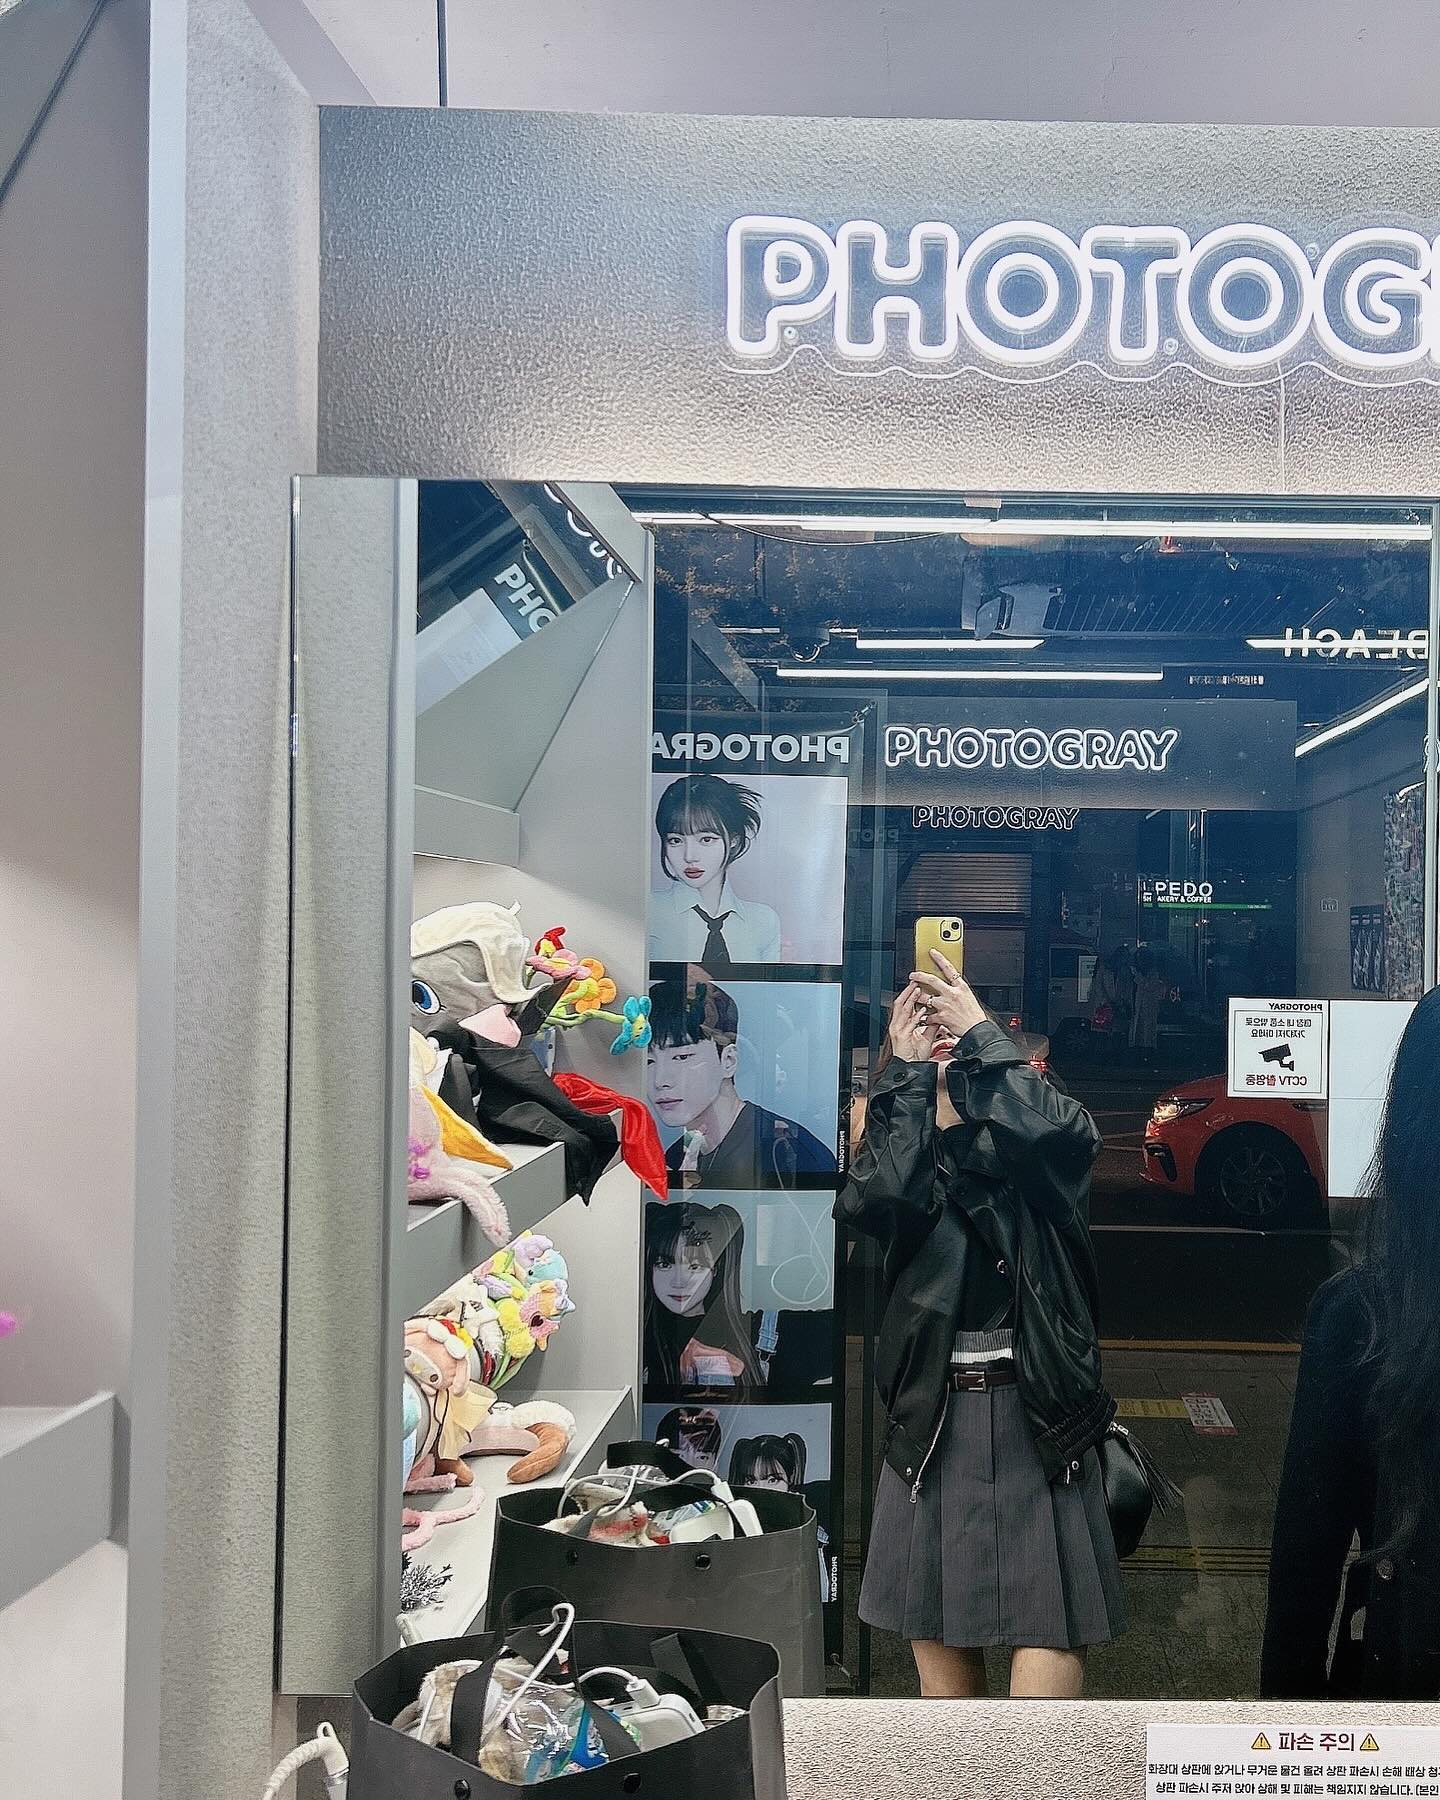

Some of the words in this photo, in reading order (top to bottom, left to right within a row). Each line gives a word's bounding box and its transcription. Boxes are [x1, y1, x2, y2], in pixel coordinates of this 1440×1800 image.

[727, 215, 1440, 367] PHOTOG
[885, 726, 1179, 771] PHOTOGRAY
[912, 805, 1080, 830] PHOTOGRAY
[1278, 1732, 1314, 1751] 파손
[1319, 1733, 1355, 1752] 주의
[1148, 1763, 1178, 1776] 화장대
[1181, 1763, 1212, 1776] 상판에
[1215, 1764, 1245, 1776] 앉거나
[1247, 1764, 1278, 1776] 무거운
[1281, 1765, 1301, 1777] 물건
[1326, 1765, 1347, 1777] 상판
[1349, 1765, 1379, 1778] 파손시
[1382, 1766, 1402, 1778] 손해
[1405, 1766, 1426, 1778] 배상
[1428, 1766, 1440, 1778] 청
[1156, 1781, 1176, 1794] 상판
[1178, 1782, 1209, 1794] 파손시
[1211, 1782, 1232, 1795] 주저
[1235, 1783, 1255, 1795] 앉아
[1258, 1783, 1278, 1795] 상해
[1281, 1784, 1291, 1795] 및
[1293, 1783, 1324, 1796] 피해는
[1326, 1783, 1367, 1796] 책임지지
[1369, 1784, 1413, 1796] 않습니다.
